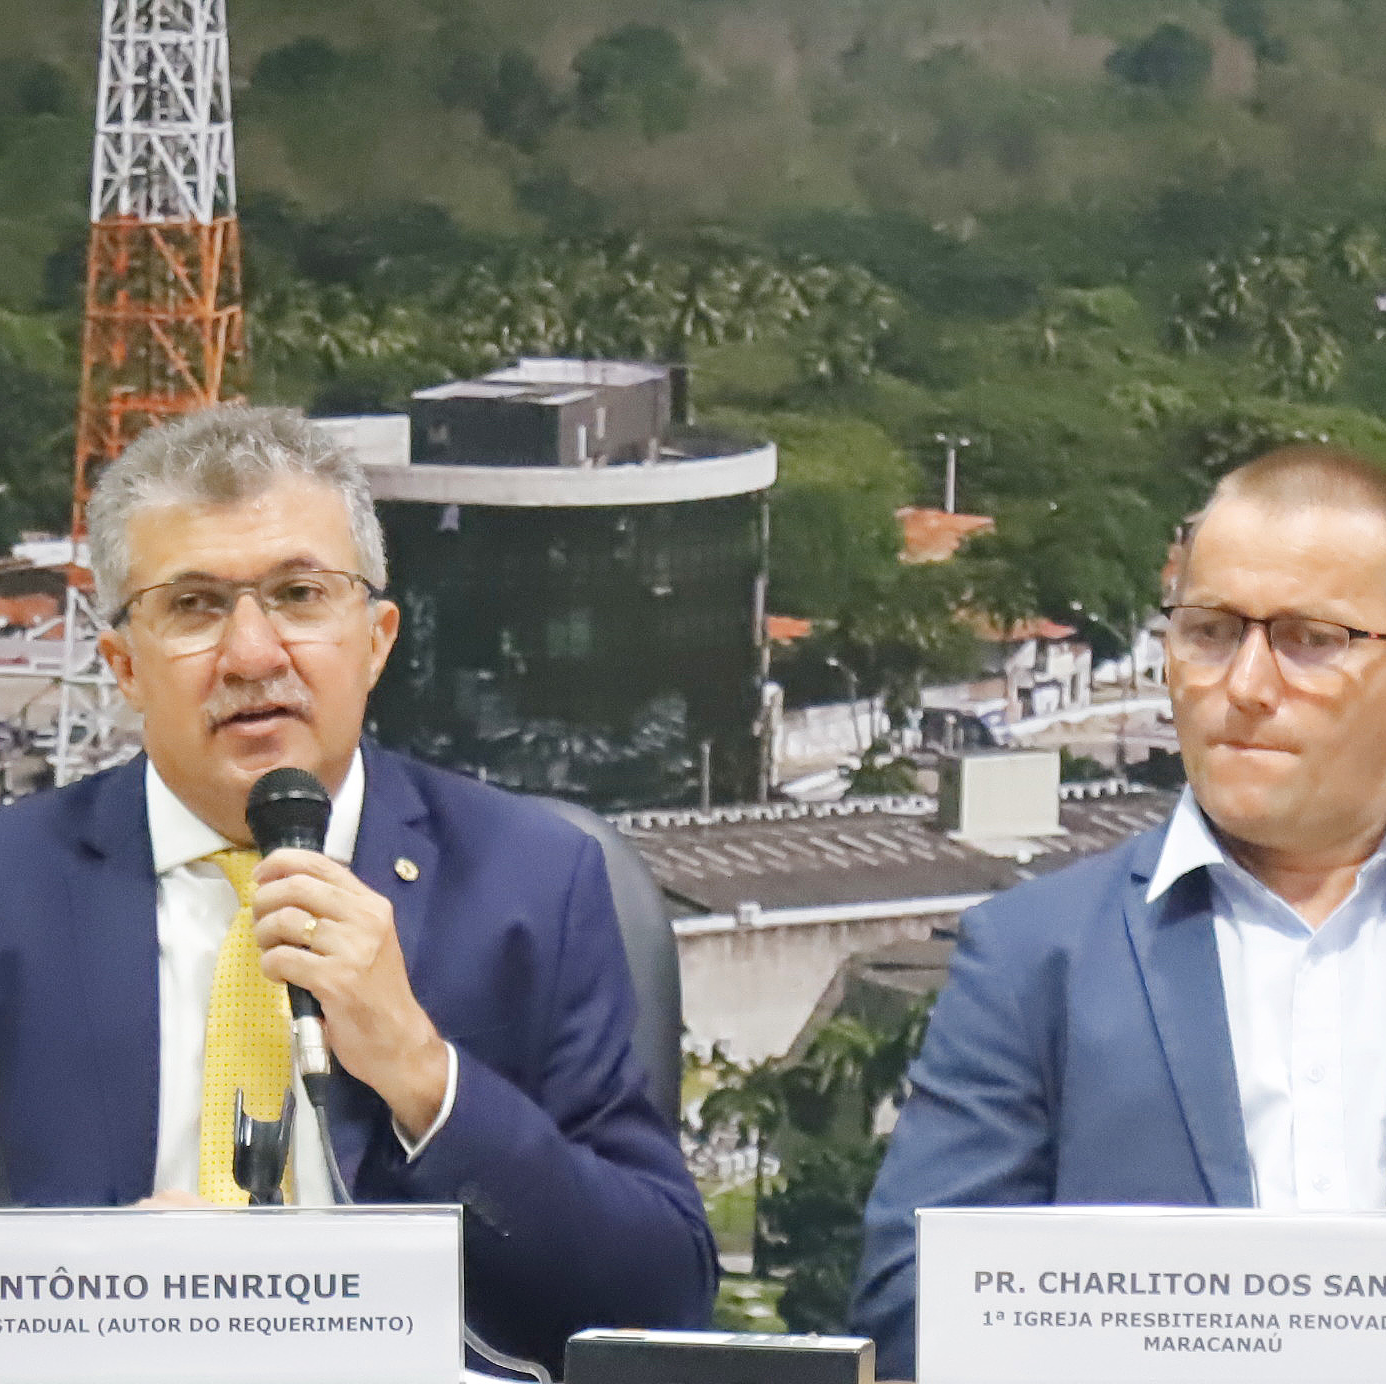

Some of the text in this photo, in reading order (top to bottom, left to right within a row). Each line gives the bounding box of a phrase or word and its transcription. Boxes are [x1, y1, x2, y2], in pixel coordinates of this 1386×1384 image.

[163, 1273, 360, 1305] HENRIQUE
[974, 1271, 1026, 1294] PR.
[1038, 1271, 1230, 1296] CHARLITON
[1244, 1273, 1312, 1297] DOS
[97, 1317, 181, 1337] (AUTOR
[189, 1317, 221, 1333] DO
[228, 1315, 414, 1336] REQUERIMENTO)
[983, 1310, 1005, 1327] 1ª
[1013, 1311, 1093, 1327] IGREJA
[1101, 1311, 1281, 1330] PRESBITERIANA
[1144, 1332, 1282, 1353] MARACANAÚ
